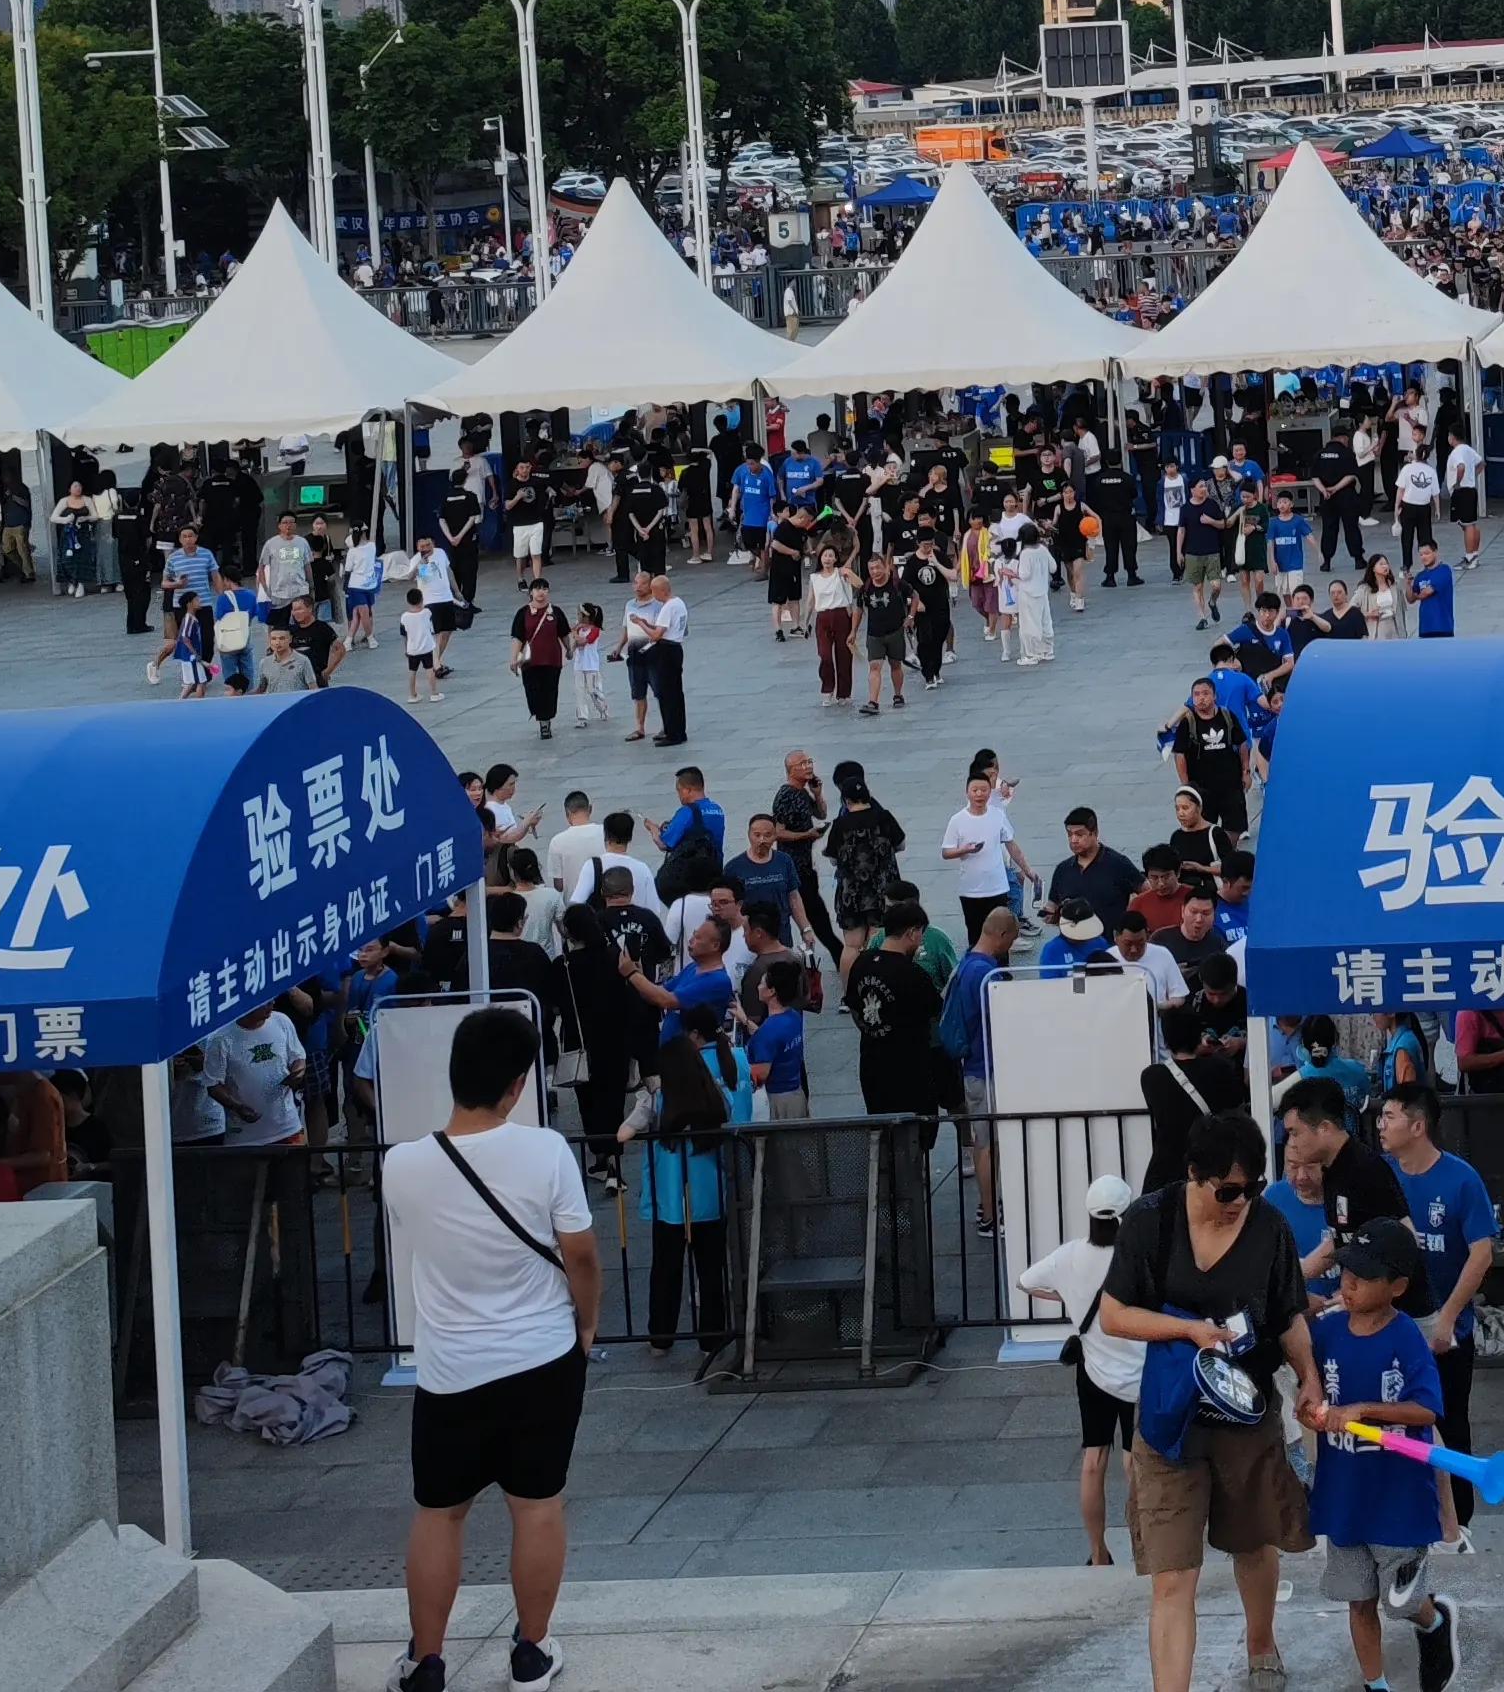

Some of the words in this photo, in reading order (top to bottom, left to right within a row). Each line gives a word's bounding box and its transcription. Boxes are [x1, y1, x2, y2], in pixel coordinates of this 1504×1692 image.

[335, 210, 480, 231] 武汉华路球迷协会
[778, 220, 790, 240] 5
[243, 734, 406, 901] 验票处
[186, 836, 457, 1029] 请主动出示身份证、门票
